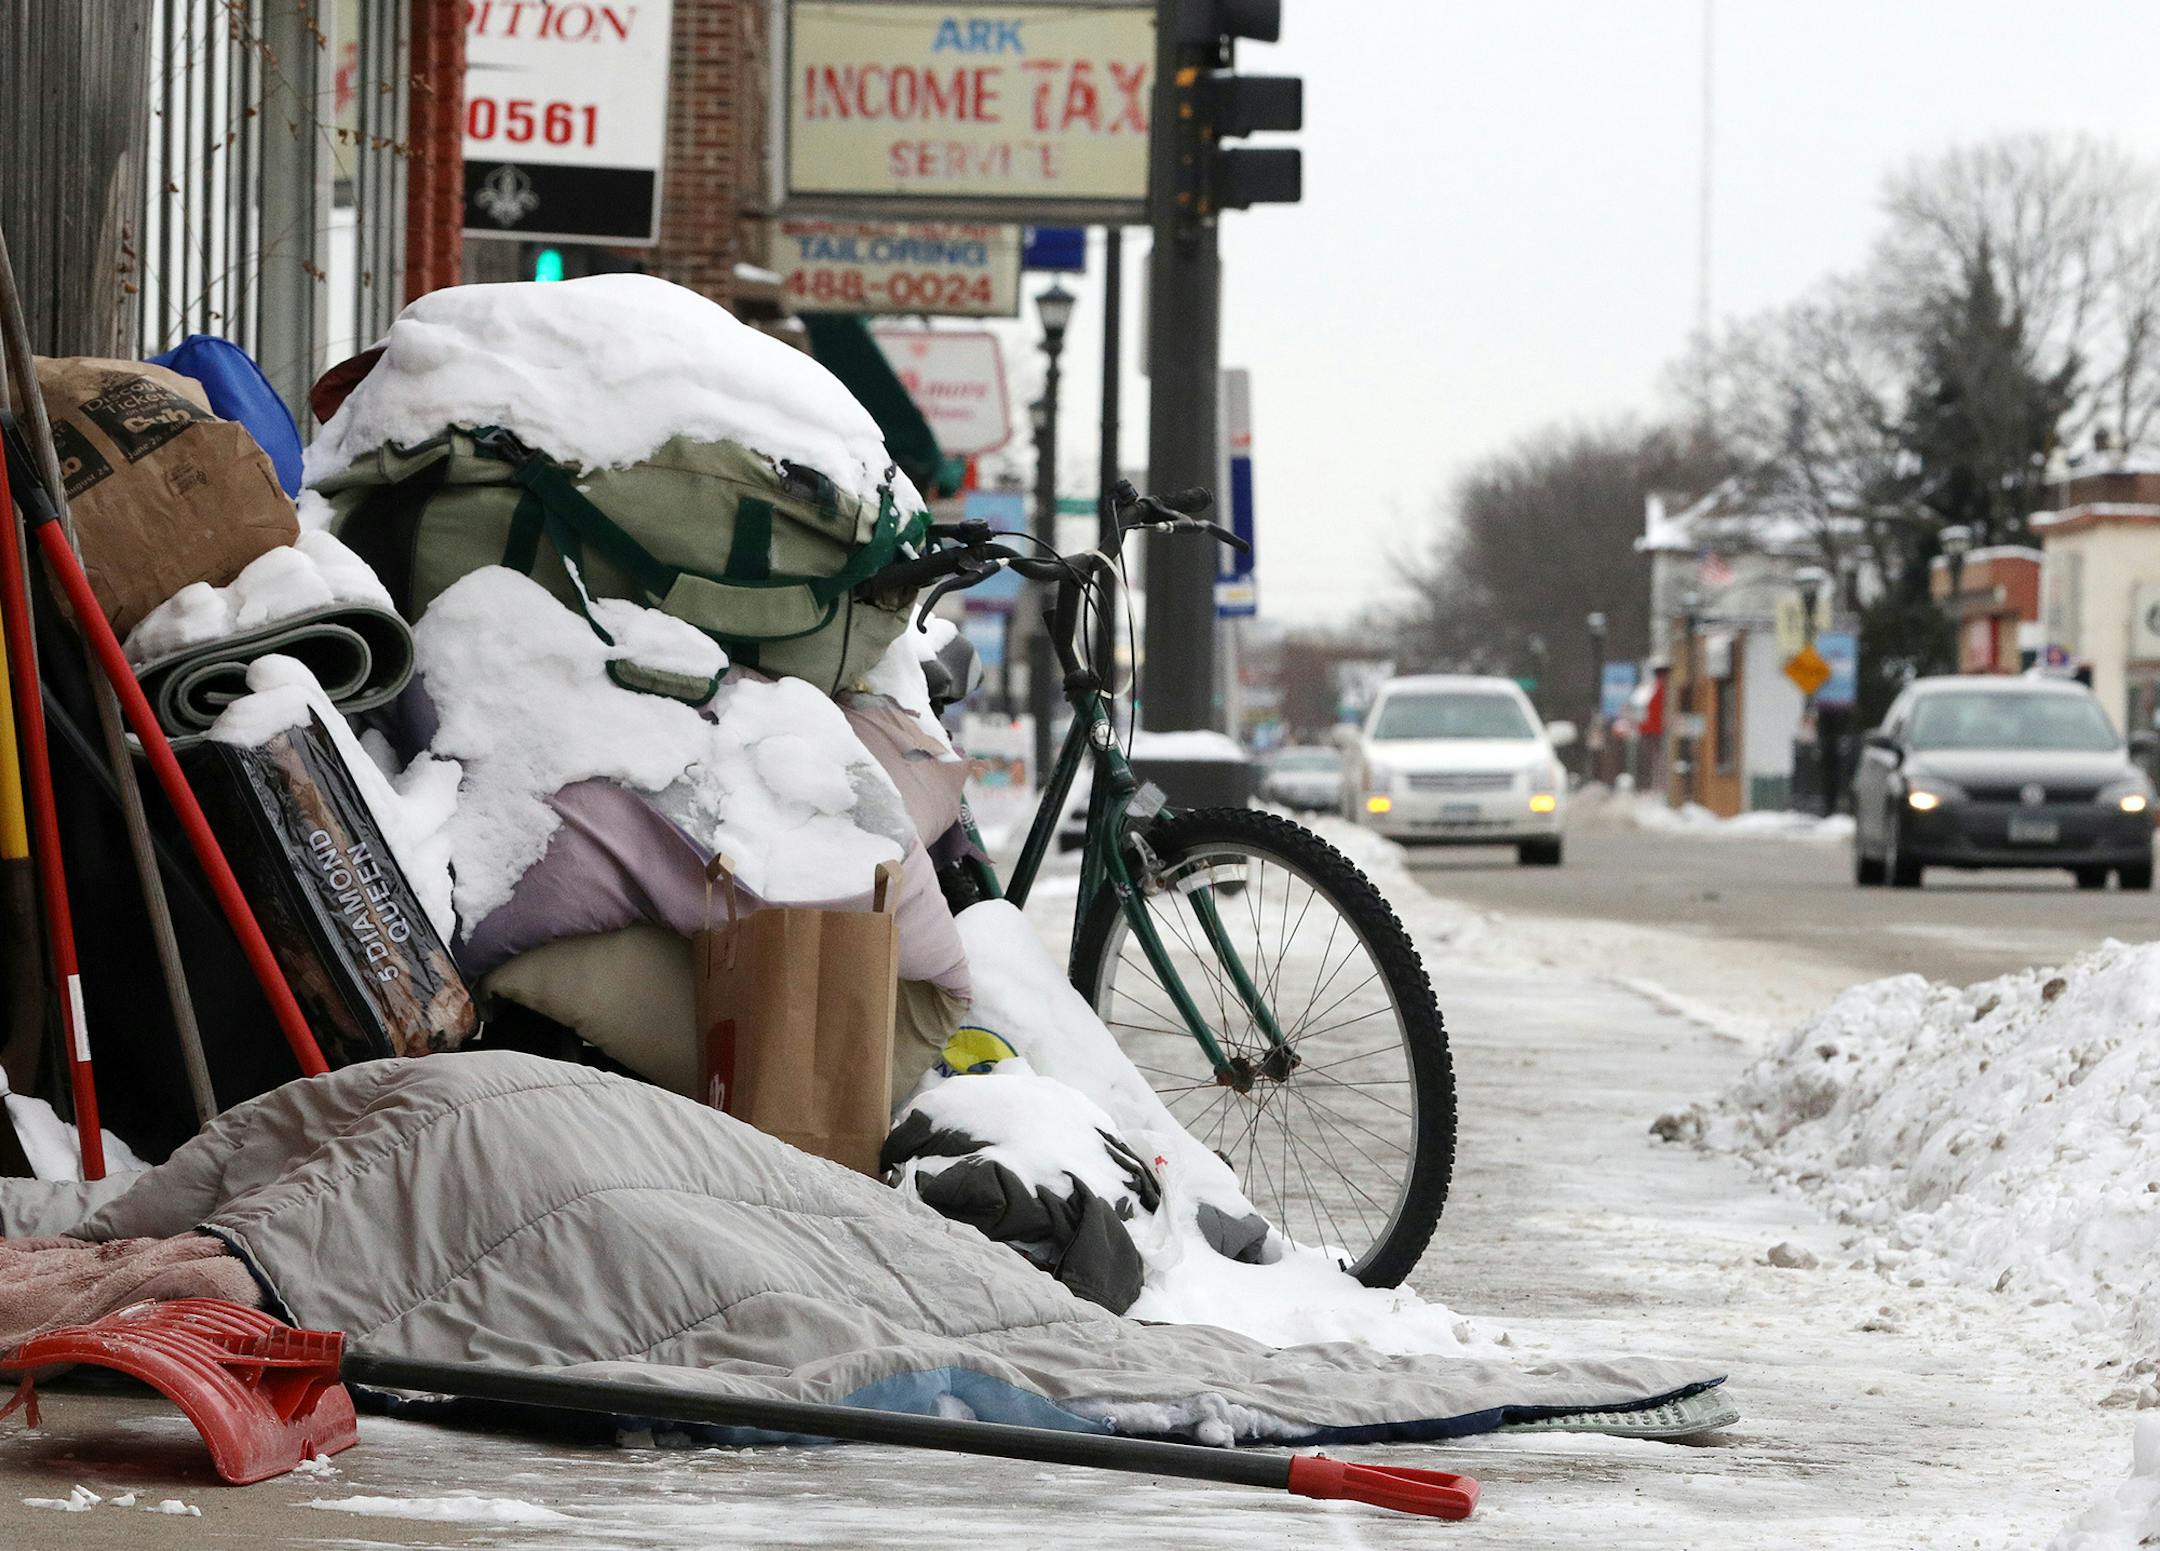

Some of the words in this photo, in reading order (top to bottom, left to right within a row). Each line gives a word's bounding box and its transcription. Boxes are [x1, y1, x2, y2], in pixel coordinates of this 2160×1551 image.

[466, 0, 638, 43] ITION
[931, 16, 1027, 55] ARK
[803, 62, 1003, 123] INCOME
[1021, 58, 1149, 134] TAX
[799, 233, 988, 267] TAILORING
[785, 268, 992, 305] 488-0024
[309, 829, 389, 963] DIAMOND
[346, 841, 411, 943] QUEEN
[377, 965, 399, 983] 5
